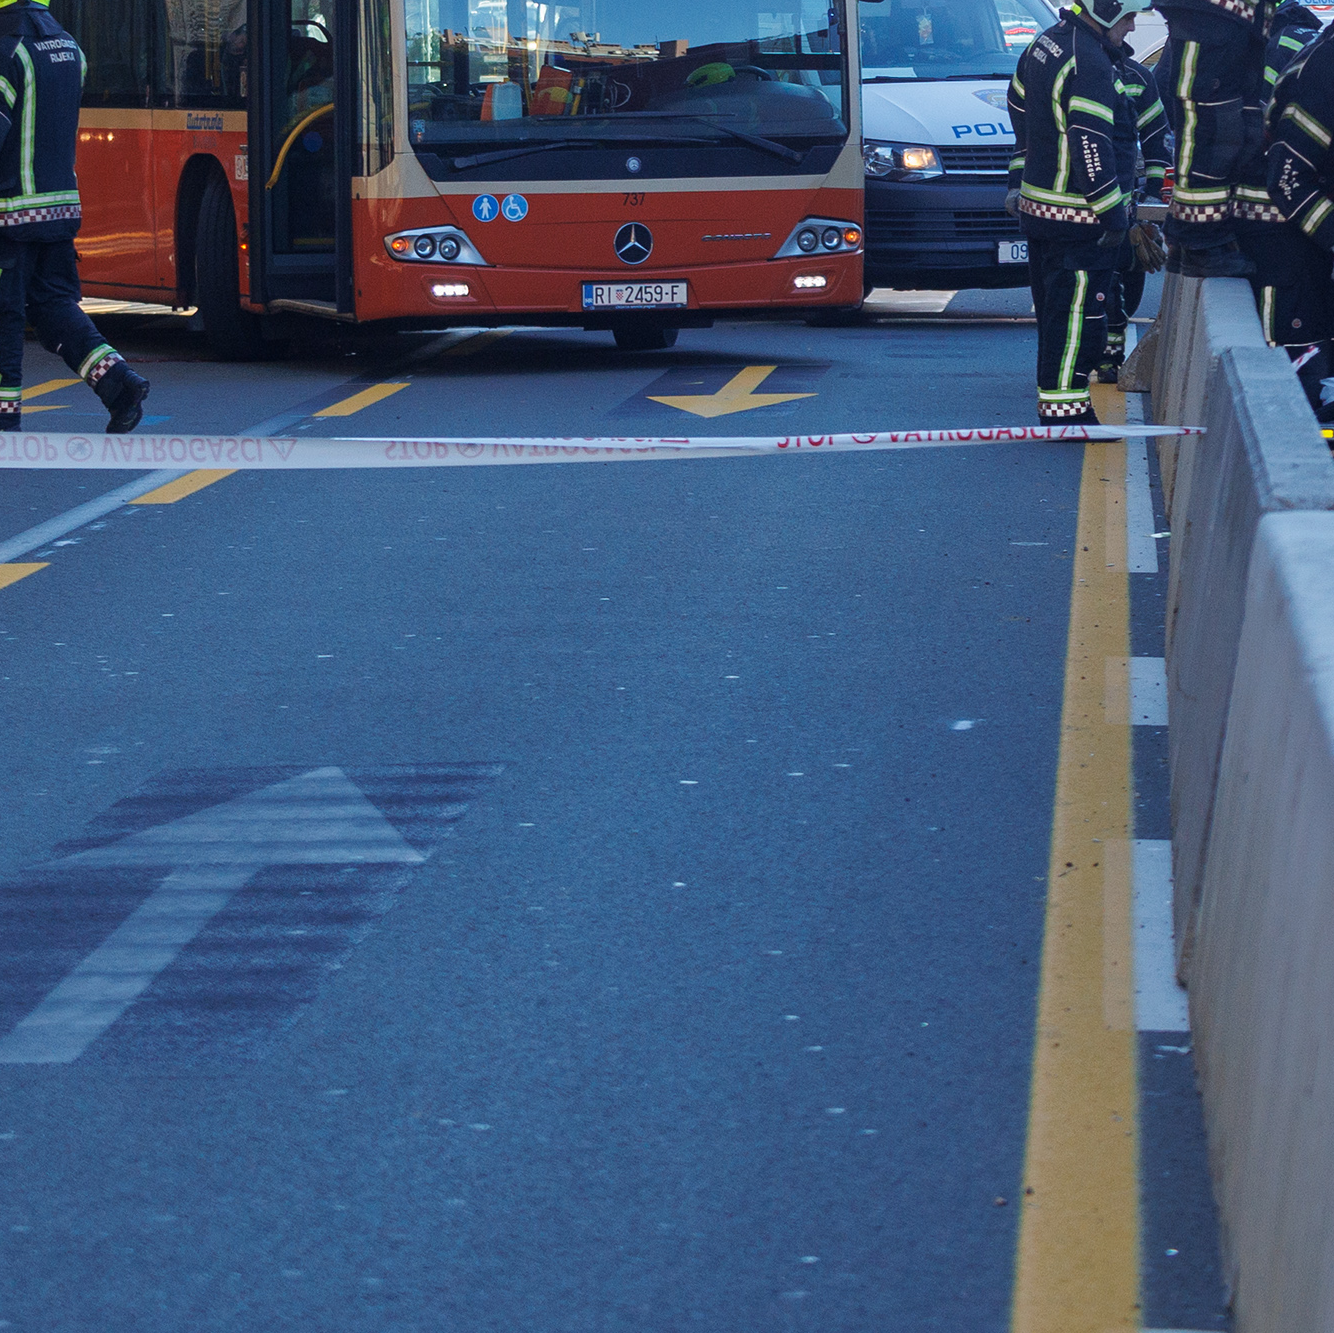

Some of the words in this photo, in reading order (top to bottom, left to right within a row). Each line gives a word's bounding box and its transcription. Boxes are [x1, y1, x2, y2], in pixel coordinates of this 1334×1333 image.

[622, 192, 646, 206] 737
[1011, 243, 1028, 259] 09
[594, 286, 612, 304] RI
[624, 284, 680, 303] 2459-F
